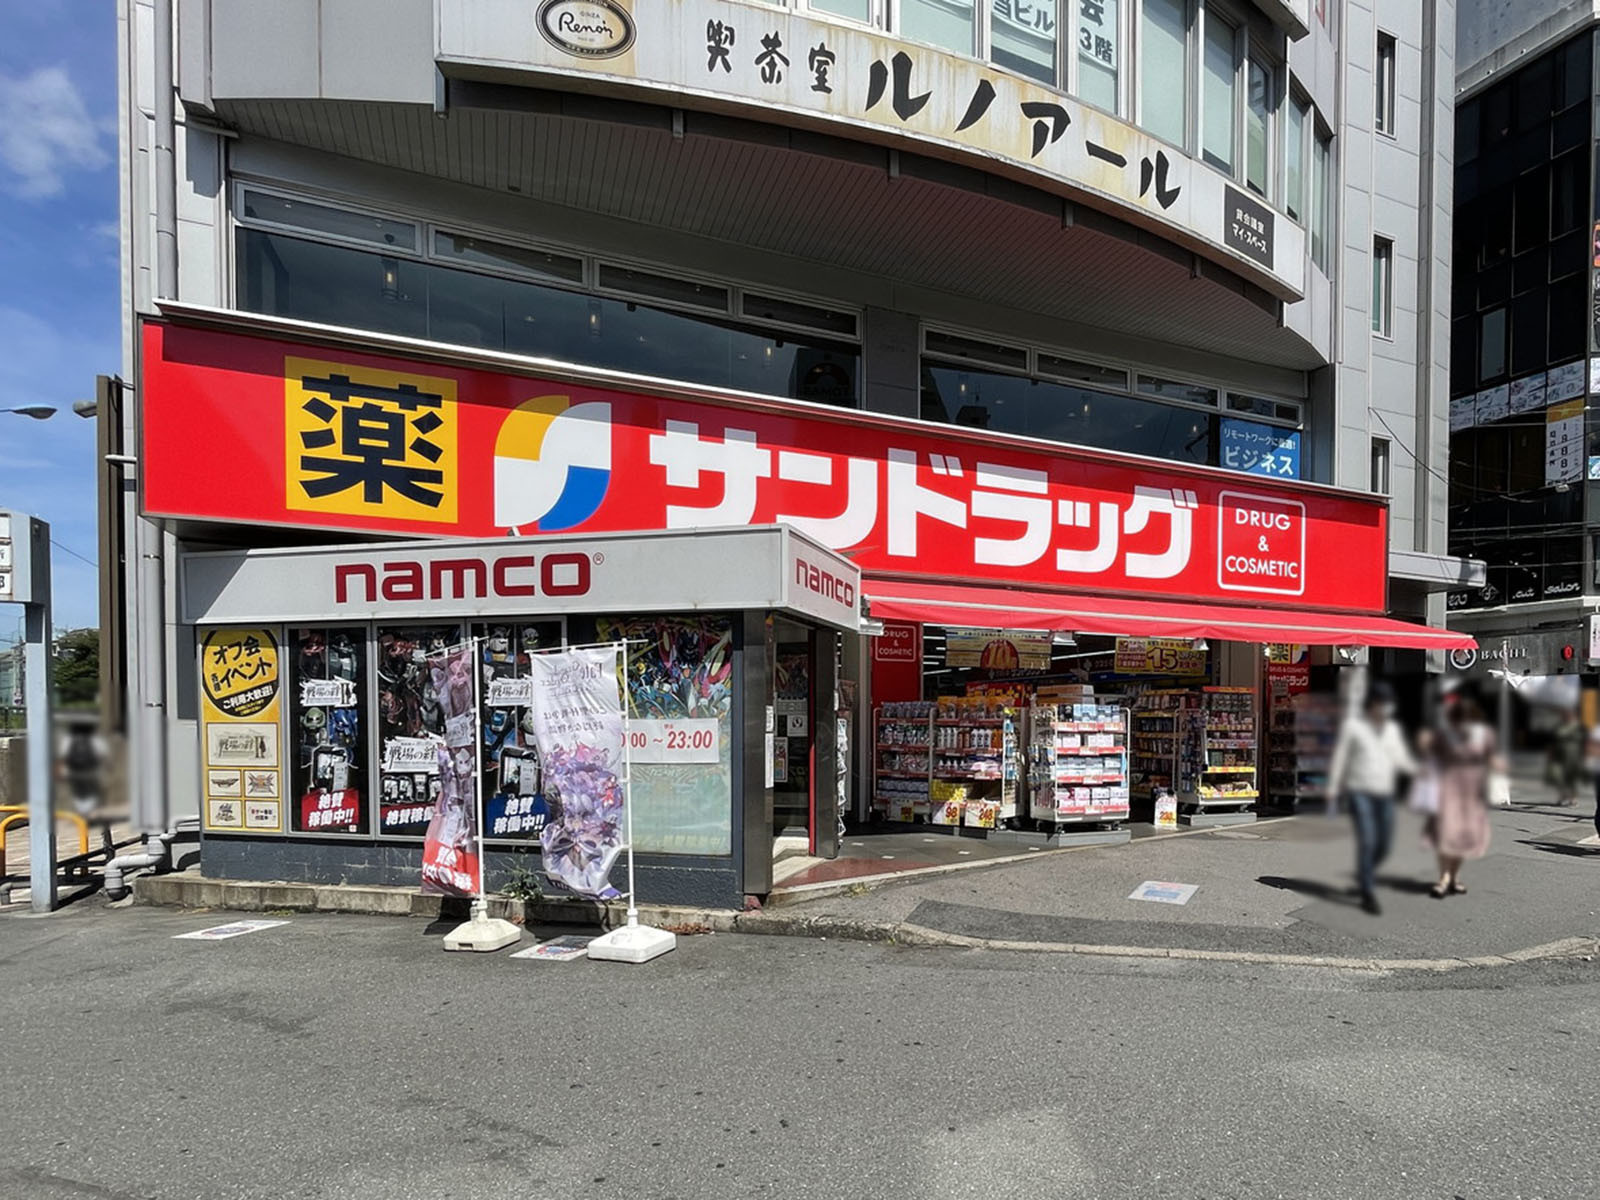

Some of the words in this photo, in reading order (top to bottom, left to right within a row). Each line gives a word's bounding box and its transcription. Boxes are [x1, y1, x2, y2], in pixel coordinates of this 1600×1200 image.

[558, 11, 614, 39] Renoir
[1079, 27, 1113, 64] 3階
[706, 18, 836, 94] 喫茶室
[865, 50, 1182, 210] ルノアール
[299, 373, 444, 509] 薬
[1225, 446, 1294, 476] ビジネス
[649, 418, 1199, 580] サンドラッグ
[1235, 508, 1291, 531] DRUG
[1257, 535, 1270, 552] &
[335, 552, 591, 604] namco
[1225, 555, 1298, 579] COSMETIC
[796, 557, 854, 609] namco
[213, 635, 261, 665] オフ会
[220, 657, 272, 688] イベント
[667, 730, 713, 749] 23:00
[493, 814, 545, 834] 稼働中!!
